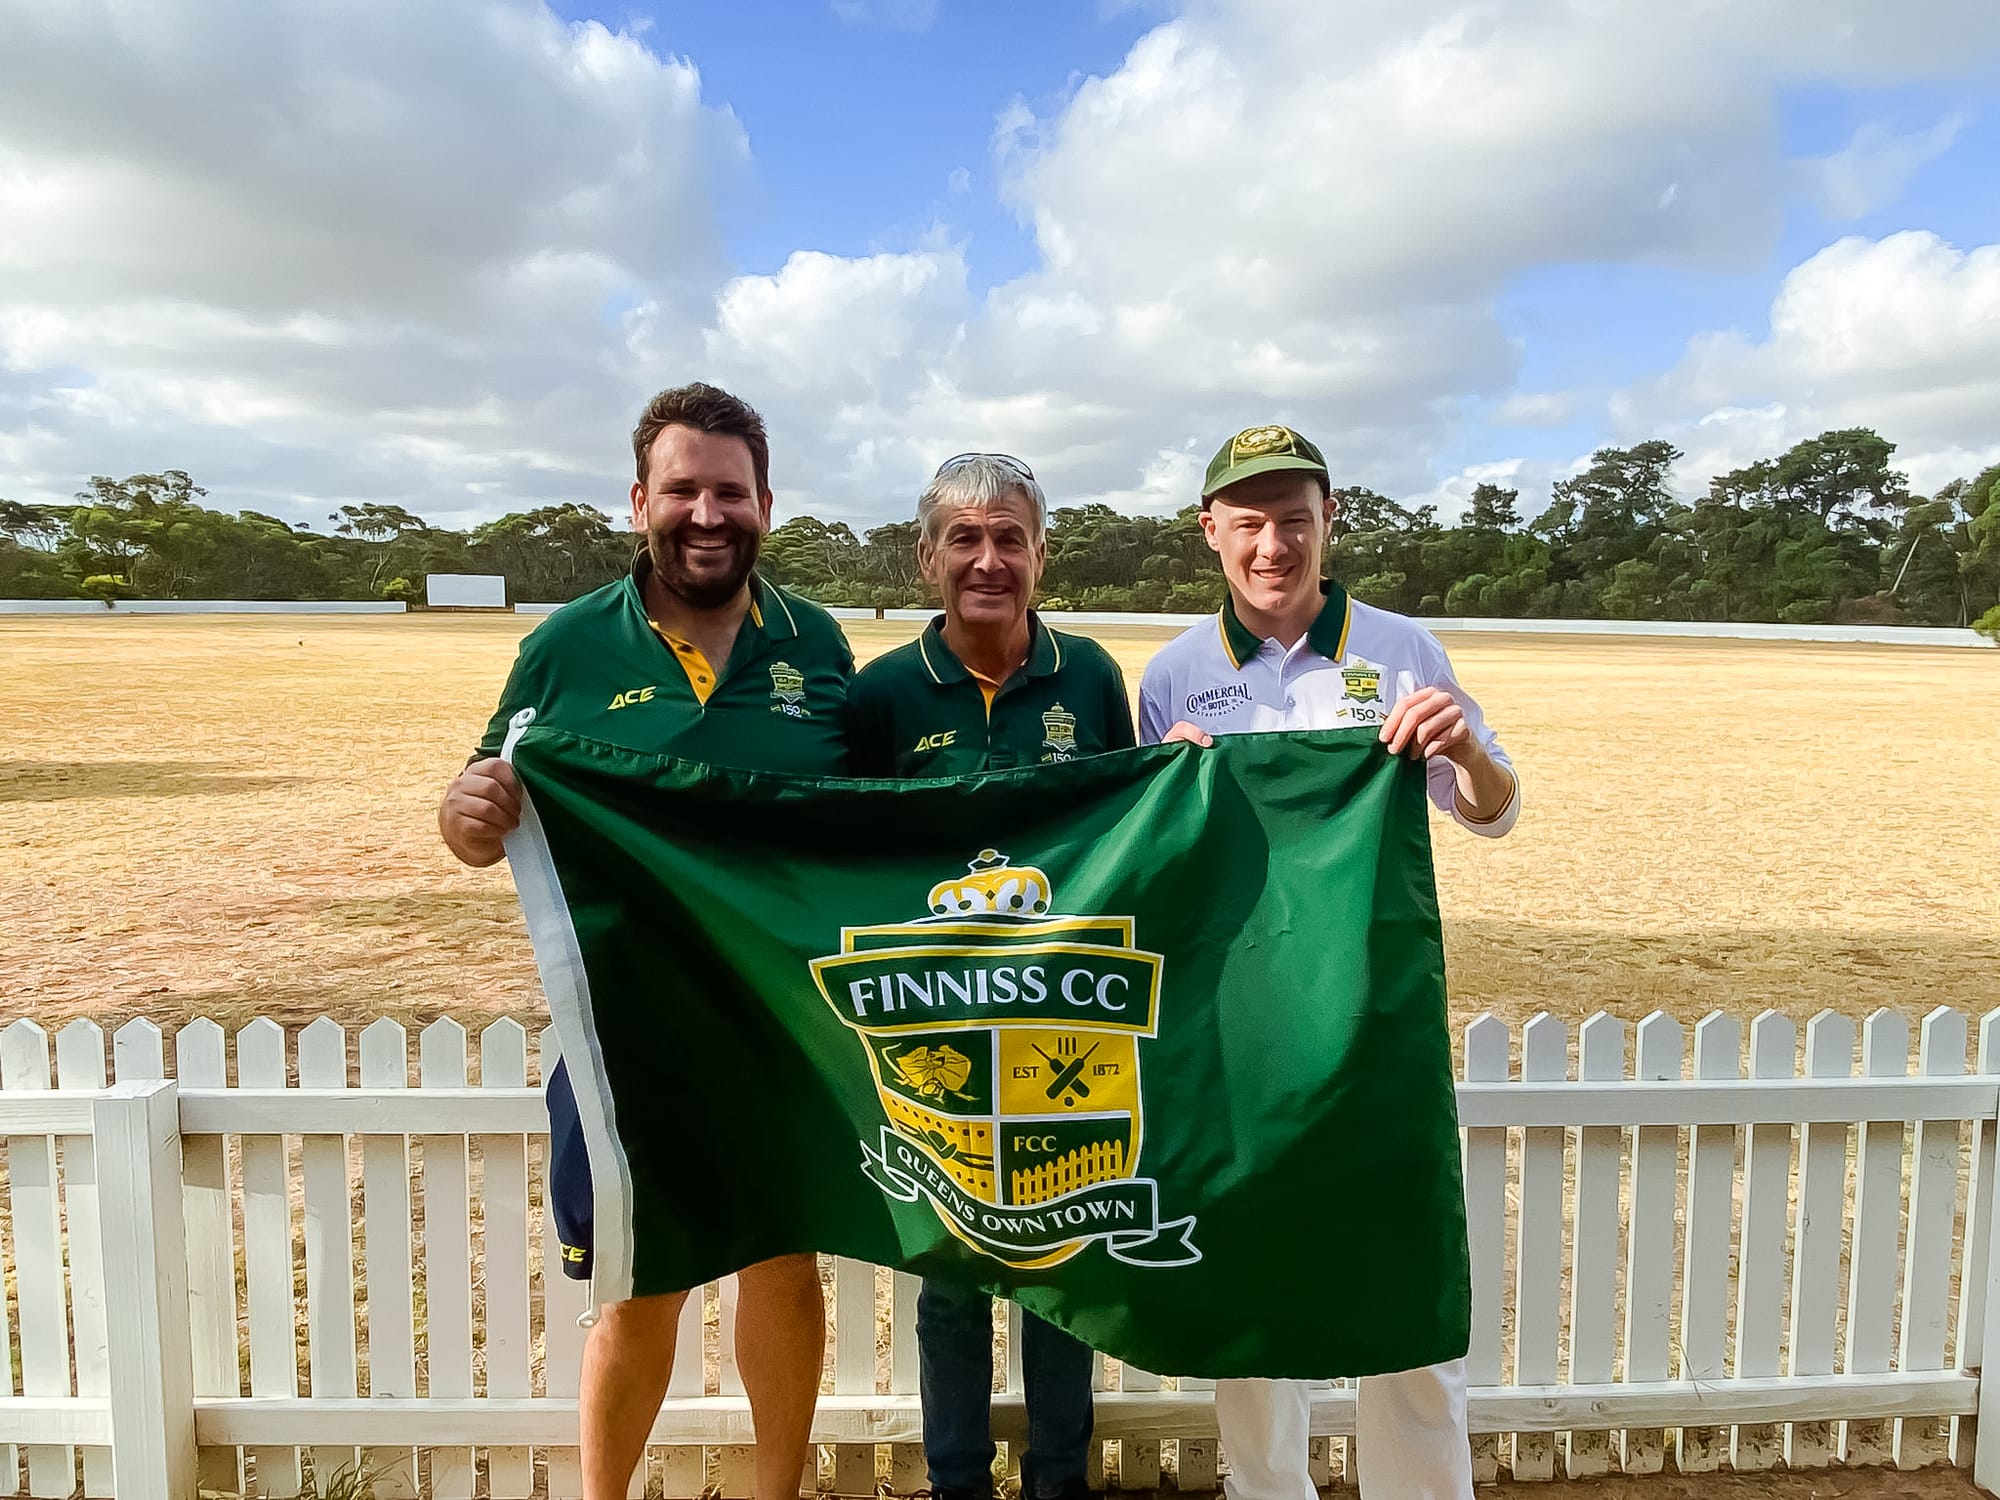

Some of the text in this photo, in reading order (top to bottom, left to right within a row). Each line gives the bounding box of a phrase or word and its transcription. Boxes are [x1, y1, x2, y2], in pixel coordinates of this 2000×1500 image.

[607, 686, 656, 710] ACE
[1186, 683, 1253, 713] COMMERCIAL
[1208, 699, 1230, 710] HOTEL
[781, 704, 800, 715] 150
[1351, 708, 1376, 721] 150
[914, 730, 957, 752] ACE
[1053, 752, 1071, 762] 150
[848, 966, 1130, 1017] FINNISS CC
[1013, 1066, 1039, 1078] EST
[1093, 1064, 1120, 1076] 1872
[1014, 1136, 1057, 1152] FCC
[897, 1146, 1135, 1234] QUEENS OWN TOWN
[560, 1243, 586, 1262] CE
